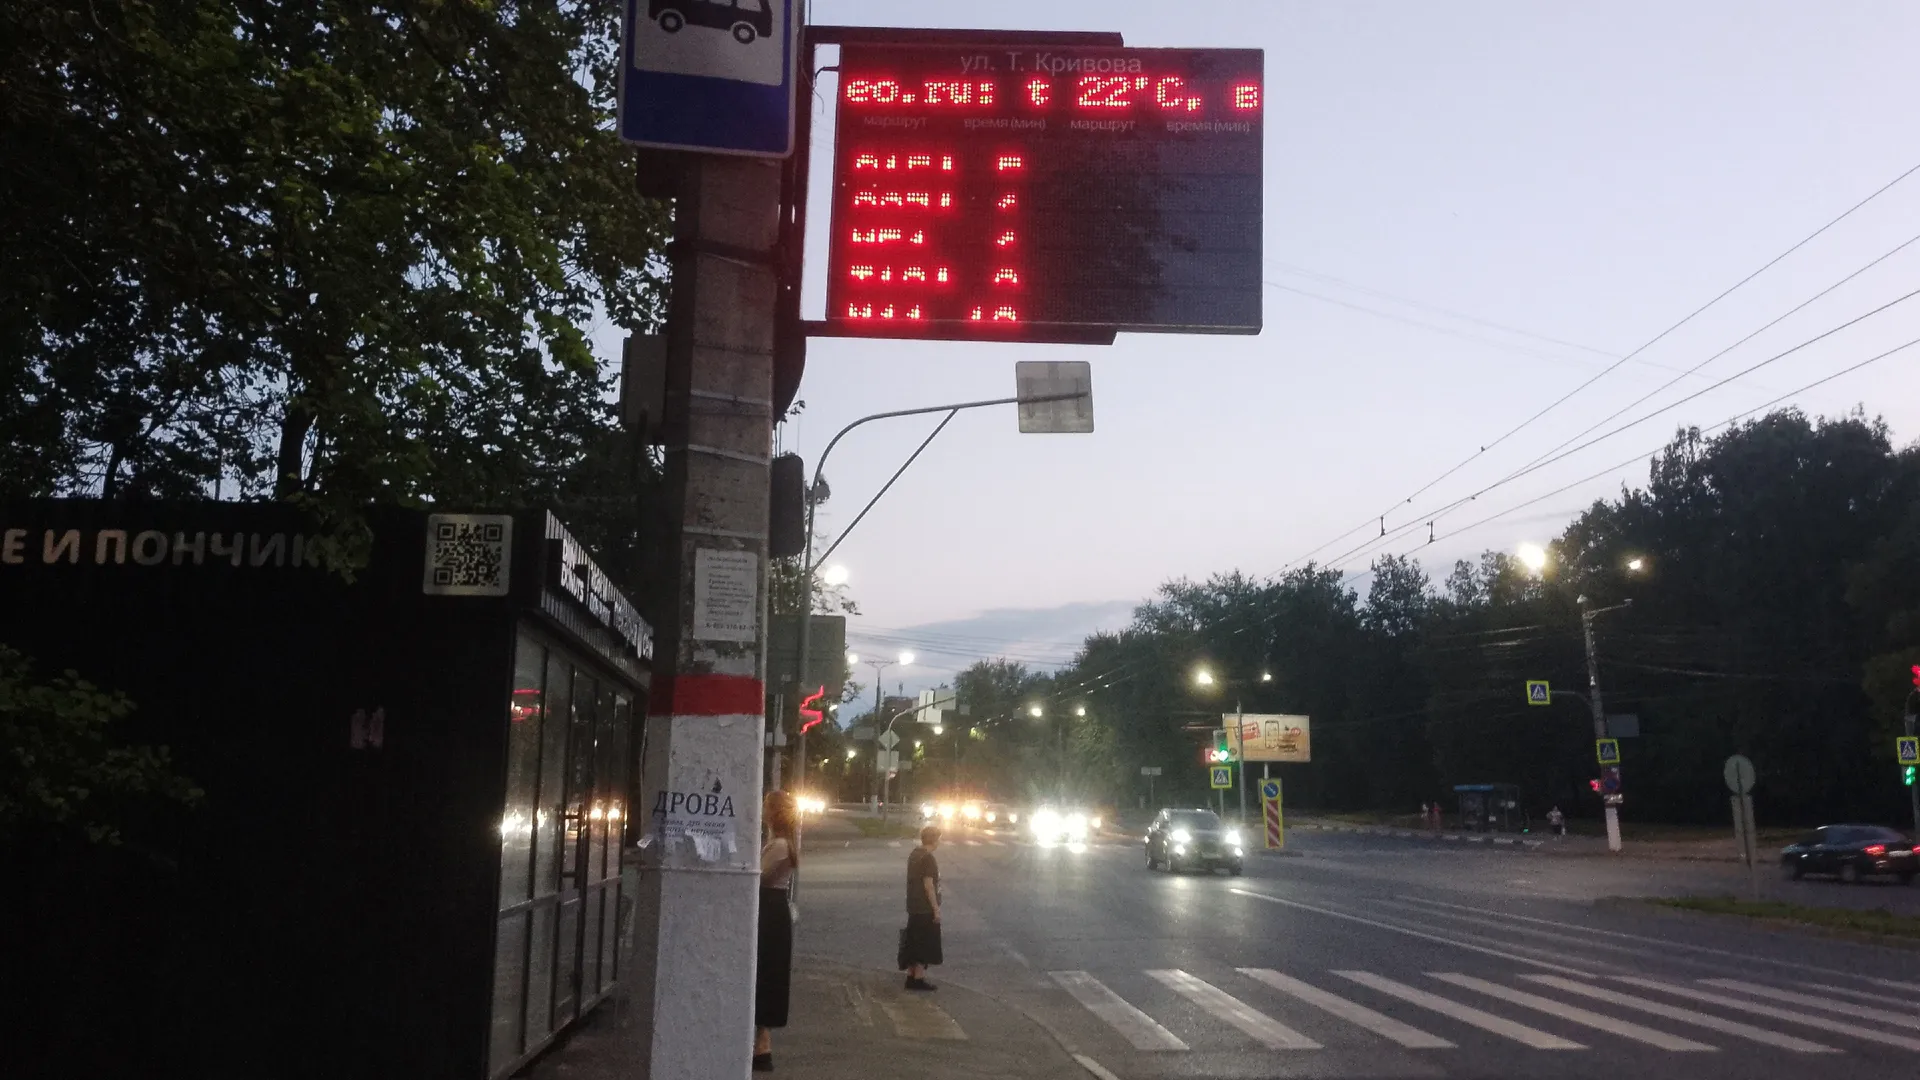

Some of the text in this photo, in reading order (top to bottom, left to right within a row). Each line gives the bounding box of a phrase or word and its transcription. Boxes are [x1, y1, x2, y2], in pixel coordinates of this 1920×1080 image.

[960, 51, 1142, 76] ул. Т. Кривова
[1028, 78, 1050, 105] t
[864, 115, 928, 129] маршрут
[964, 117, 1047, 131] время (мин)
[1070, 118, 1136, 133] маршрут
[1166, 120, 1251, 134] время (мин)
[42, 528, 81, 566] И
[652, 790, 735, 818] ДРОВА
